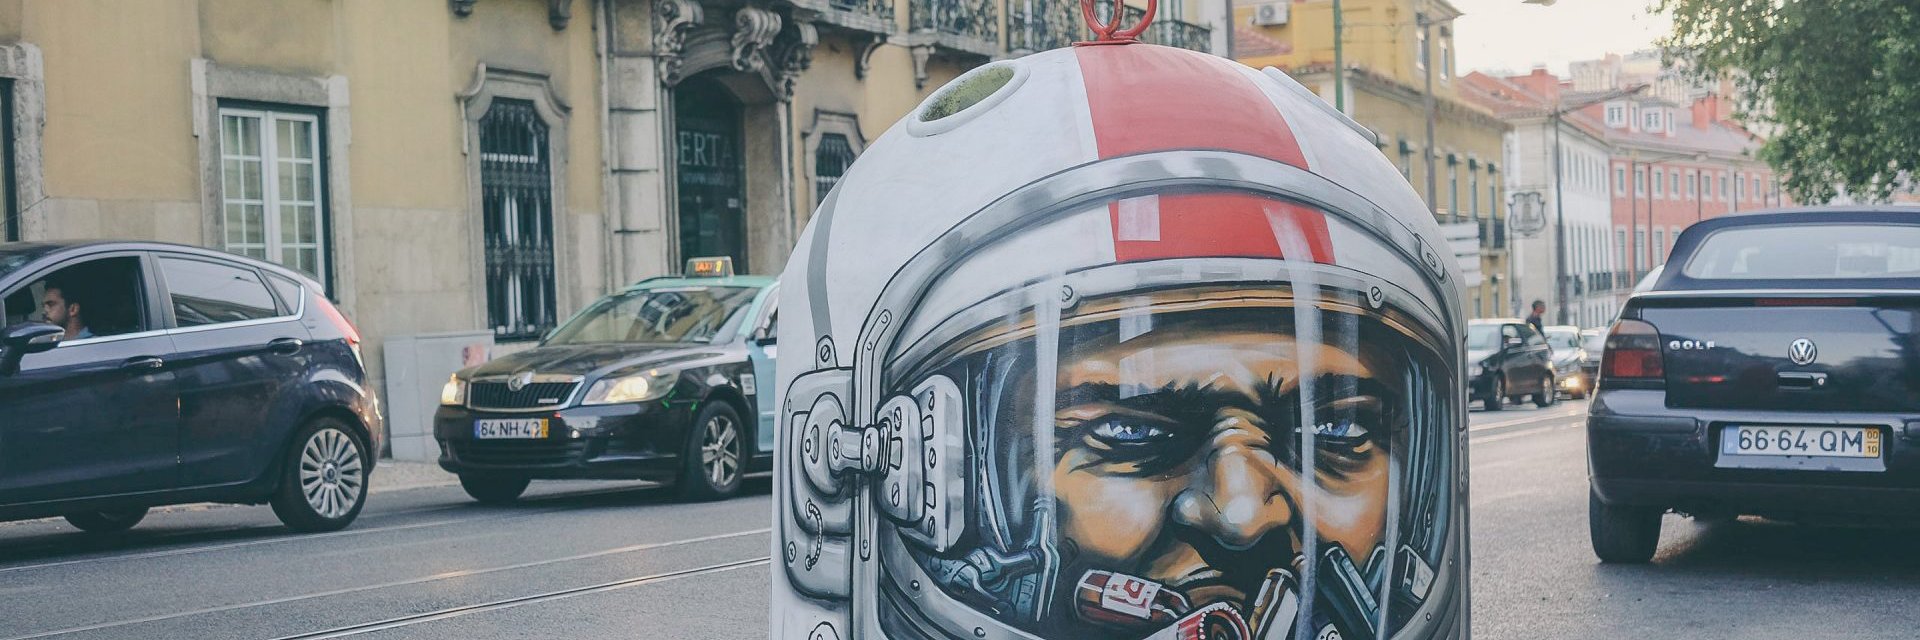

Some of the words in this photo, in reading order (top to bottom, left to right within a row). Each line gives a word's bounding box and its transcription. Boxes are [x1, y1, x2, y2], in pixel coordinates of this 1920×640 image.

[1669, 340, 1715, 350] GOLF
[1866, 430, 1879, 439] 00
[1866, 446, 1878, 454] 10
